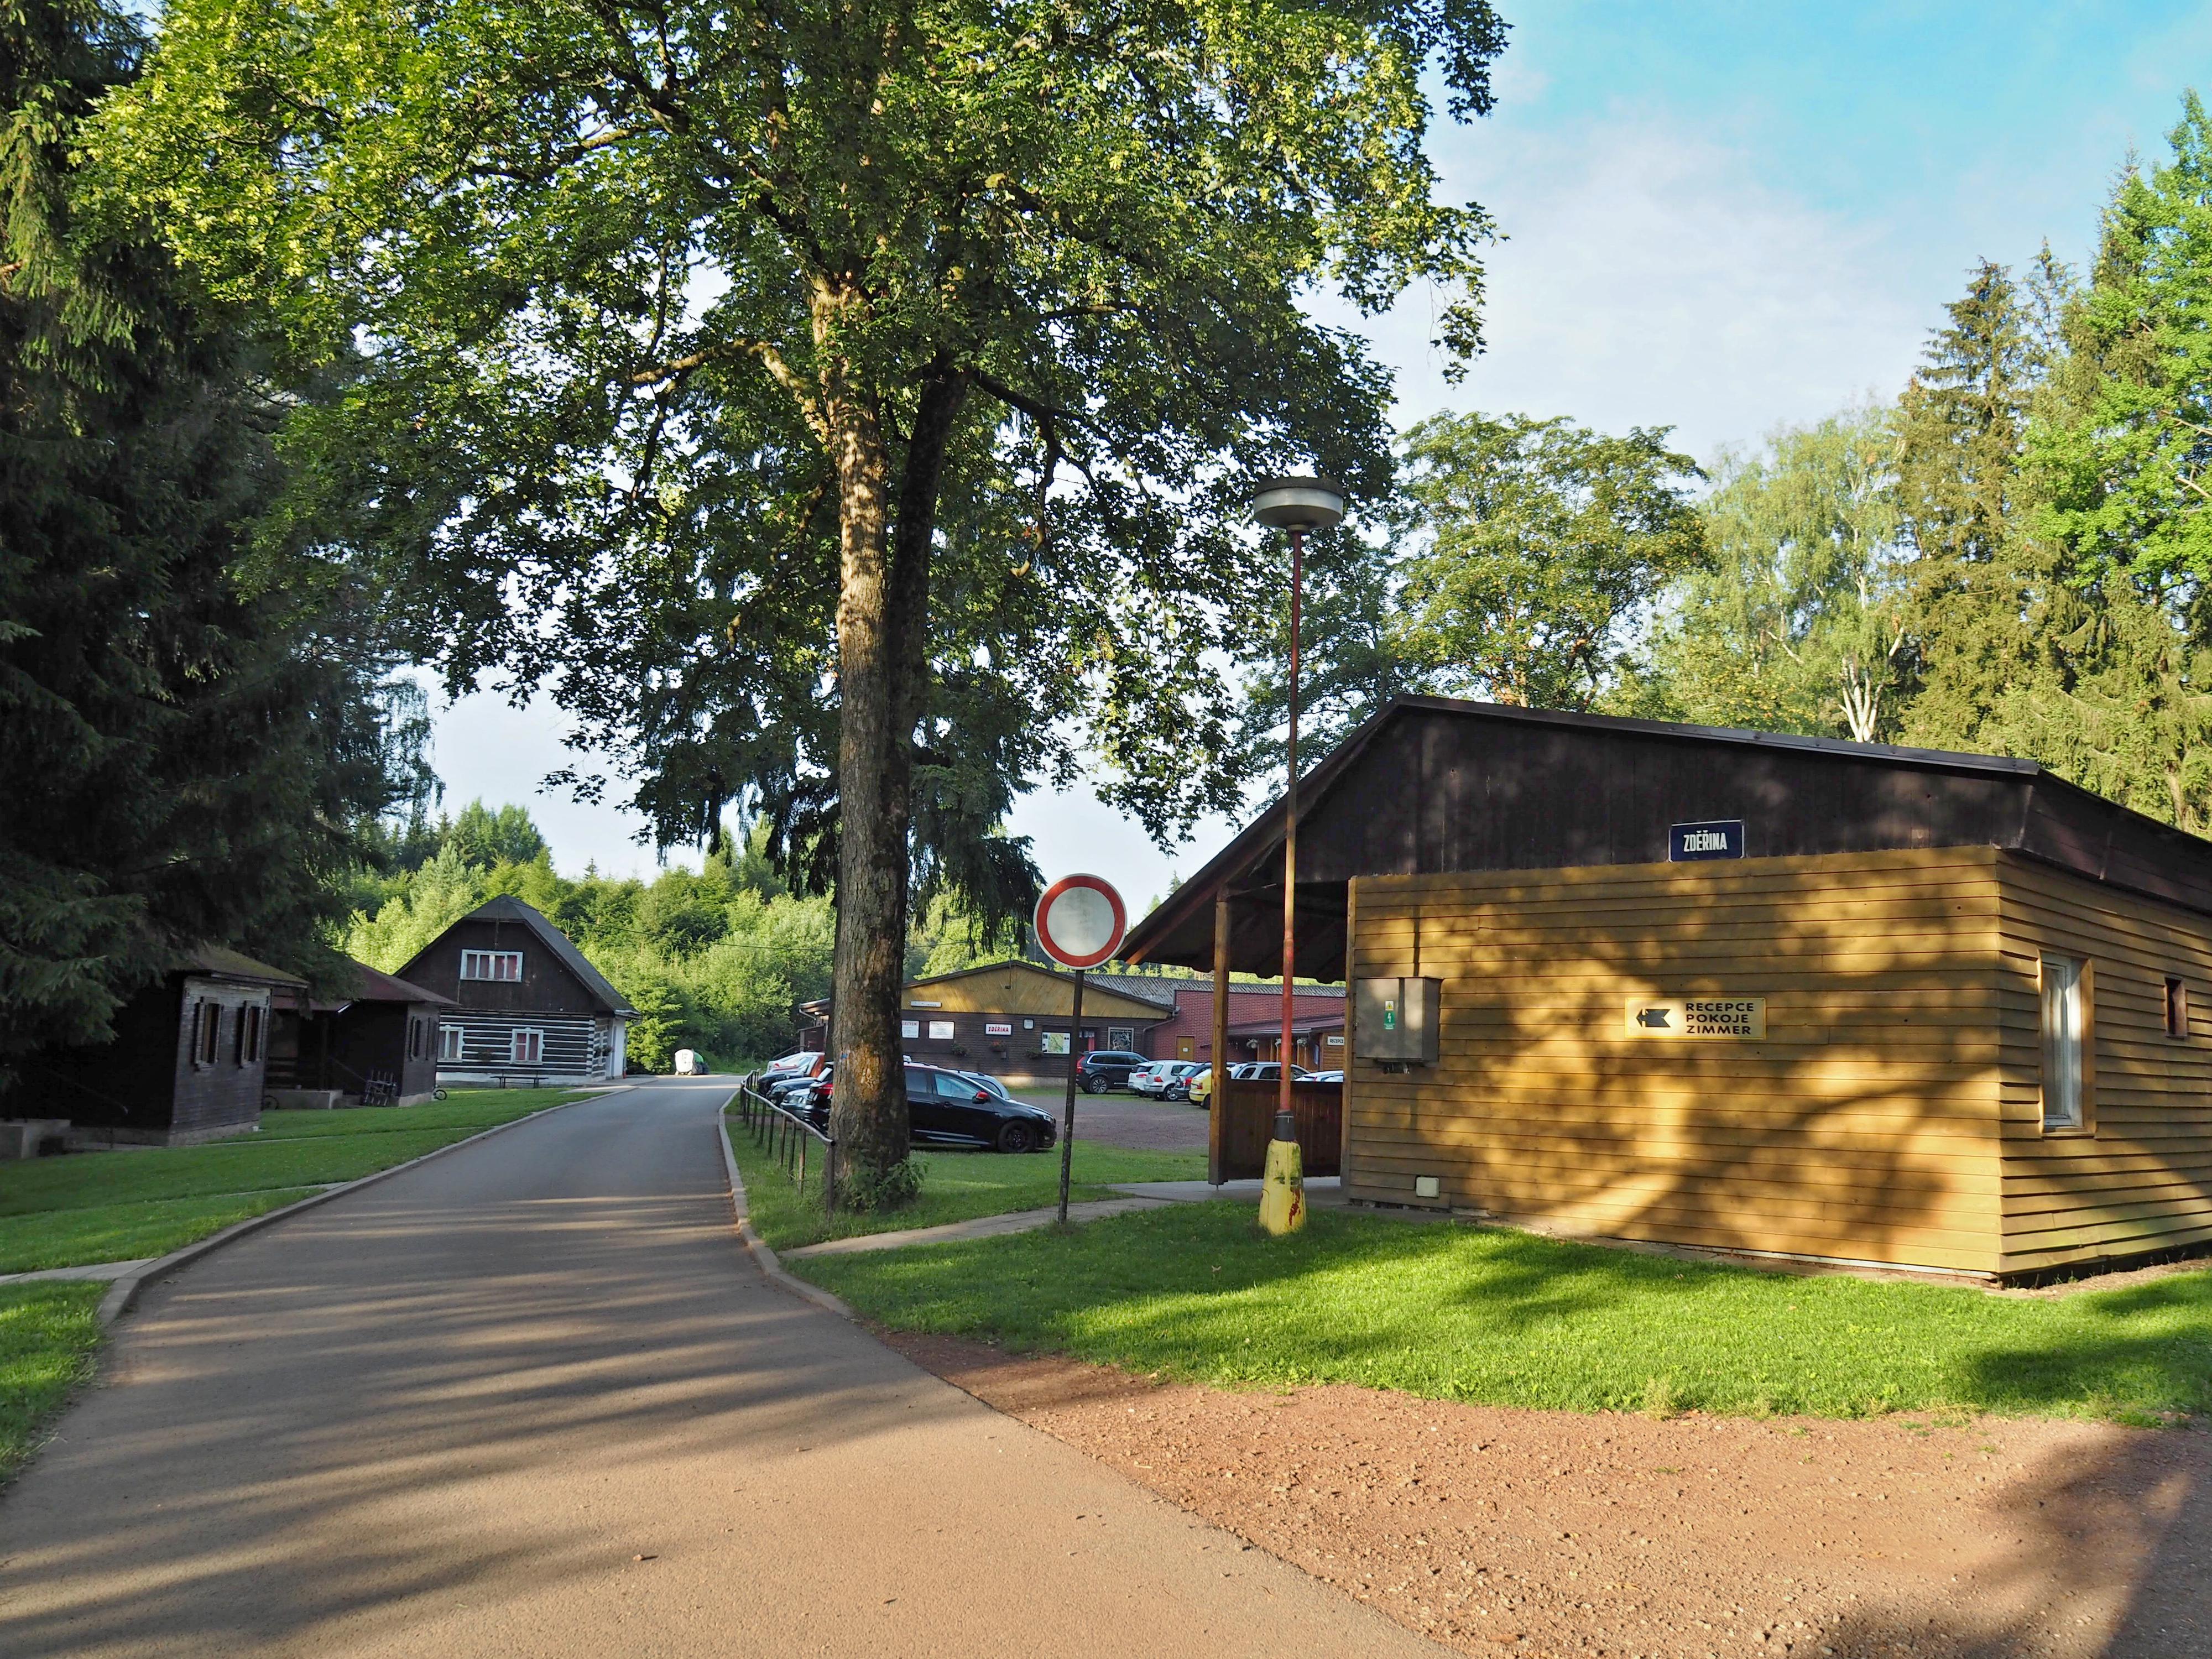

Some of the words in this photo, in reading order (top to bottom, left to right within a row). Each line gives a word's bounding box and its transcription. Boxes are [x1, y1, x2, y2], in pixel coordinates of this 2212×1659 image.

[1683, 830, 1728, 852] ZDĚŘINA
[1686, 1003, 1754, 1011] RECEPCE
[1686, 1014, 1749, 1023] POKOJE
[1686, 1025, 1751, 1035] ZIMMER
